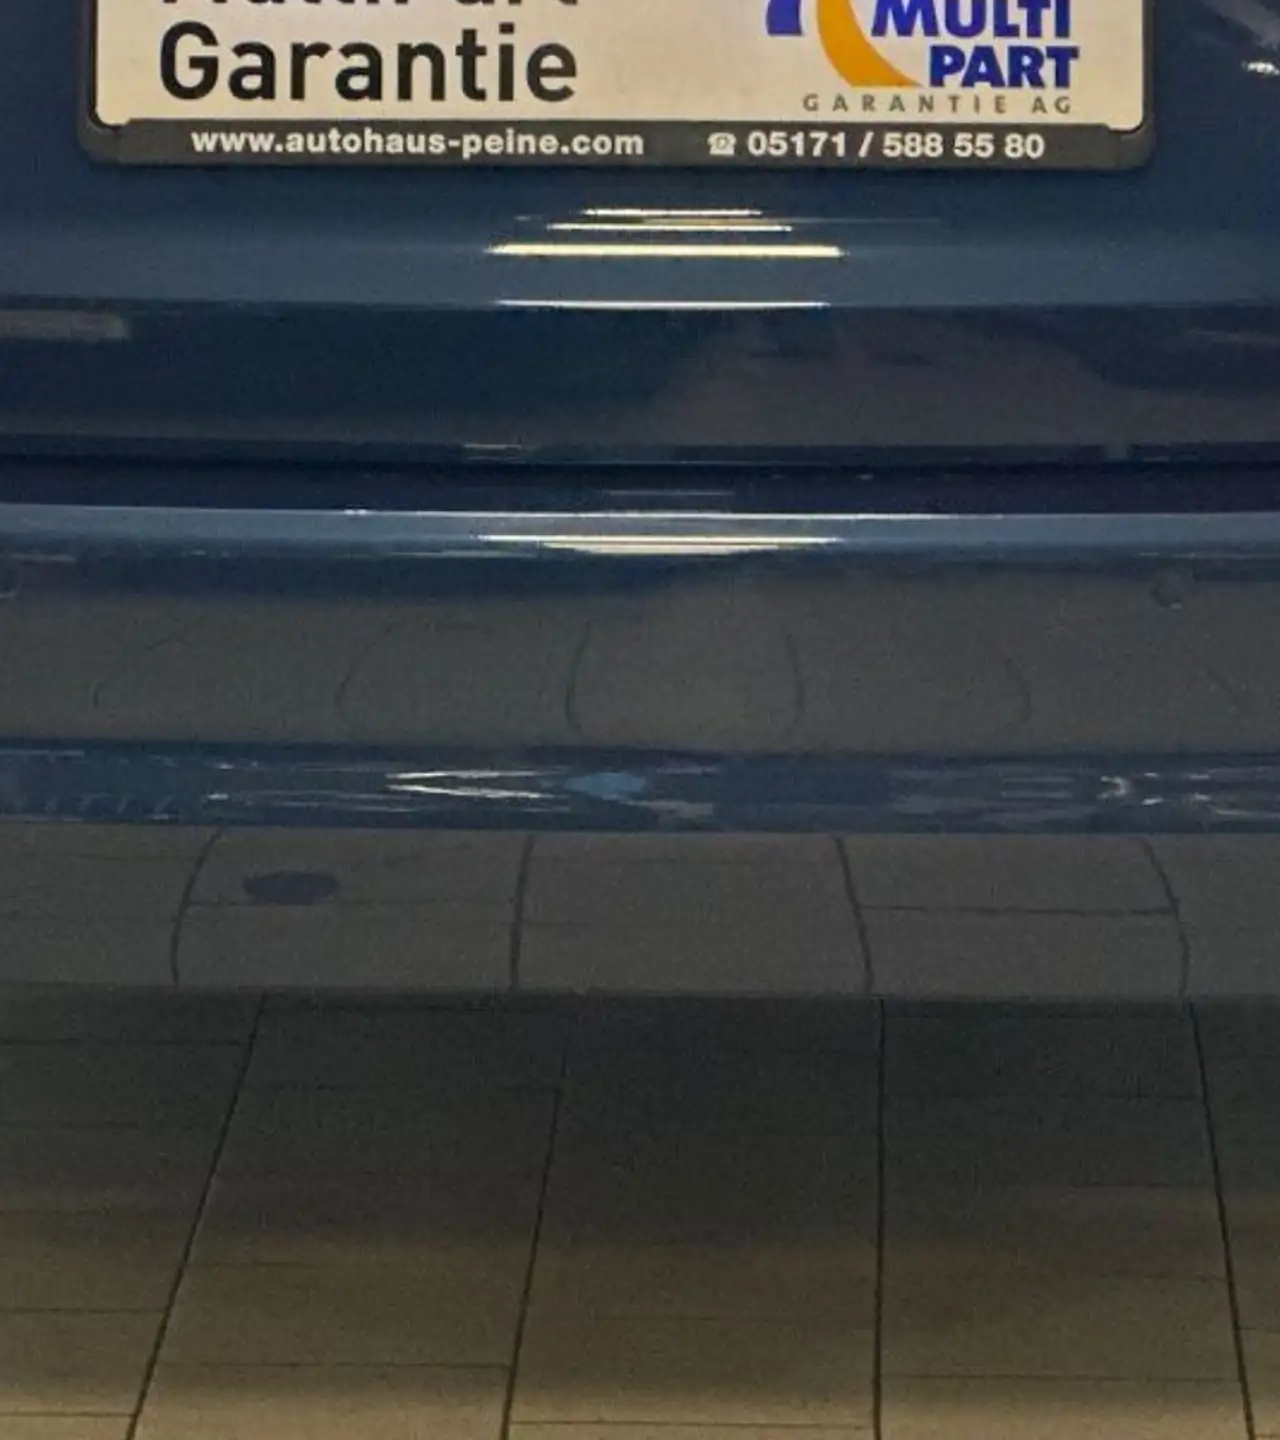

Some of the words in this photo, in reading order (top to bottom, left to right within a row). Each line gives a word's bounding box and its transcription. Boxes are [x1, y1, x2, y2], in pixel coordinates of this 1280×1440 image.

[160, 20, 578, 101] Garantie
[929, 45, 1080, 88] PART
[803, 95, 1007, 114] GARANTIE
[1032, 96, 1072, 115] AG
[191, 127, 644, 159] www.autohaus-peine.com
[748, 132, 846, 157] 05171
[859, 131, 875, 157] /
[883, 133, 944, 158] 588
[954, 133, 995, 158] 55
[1005, 133, 1045, 159] 80
